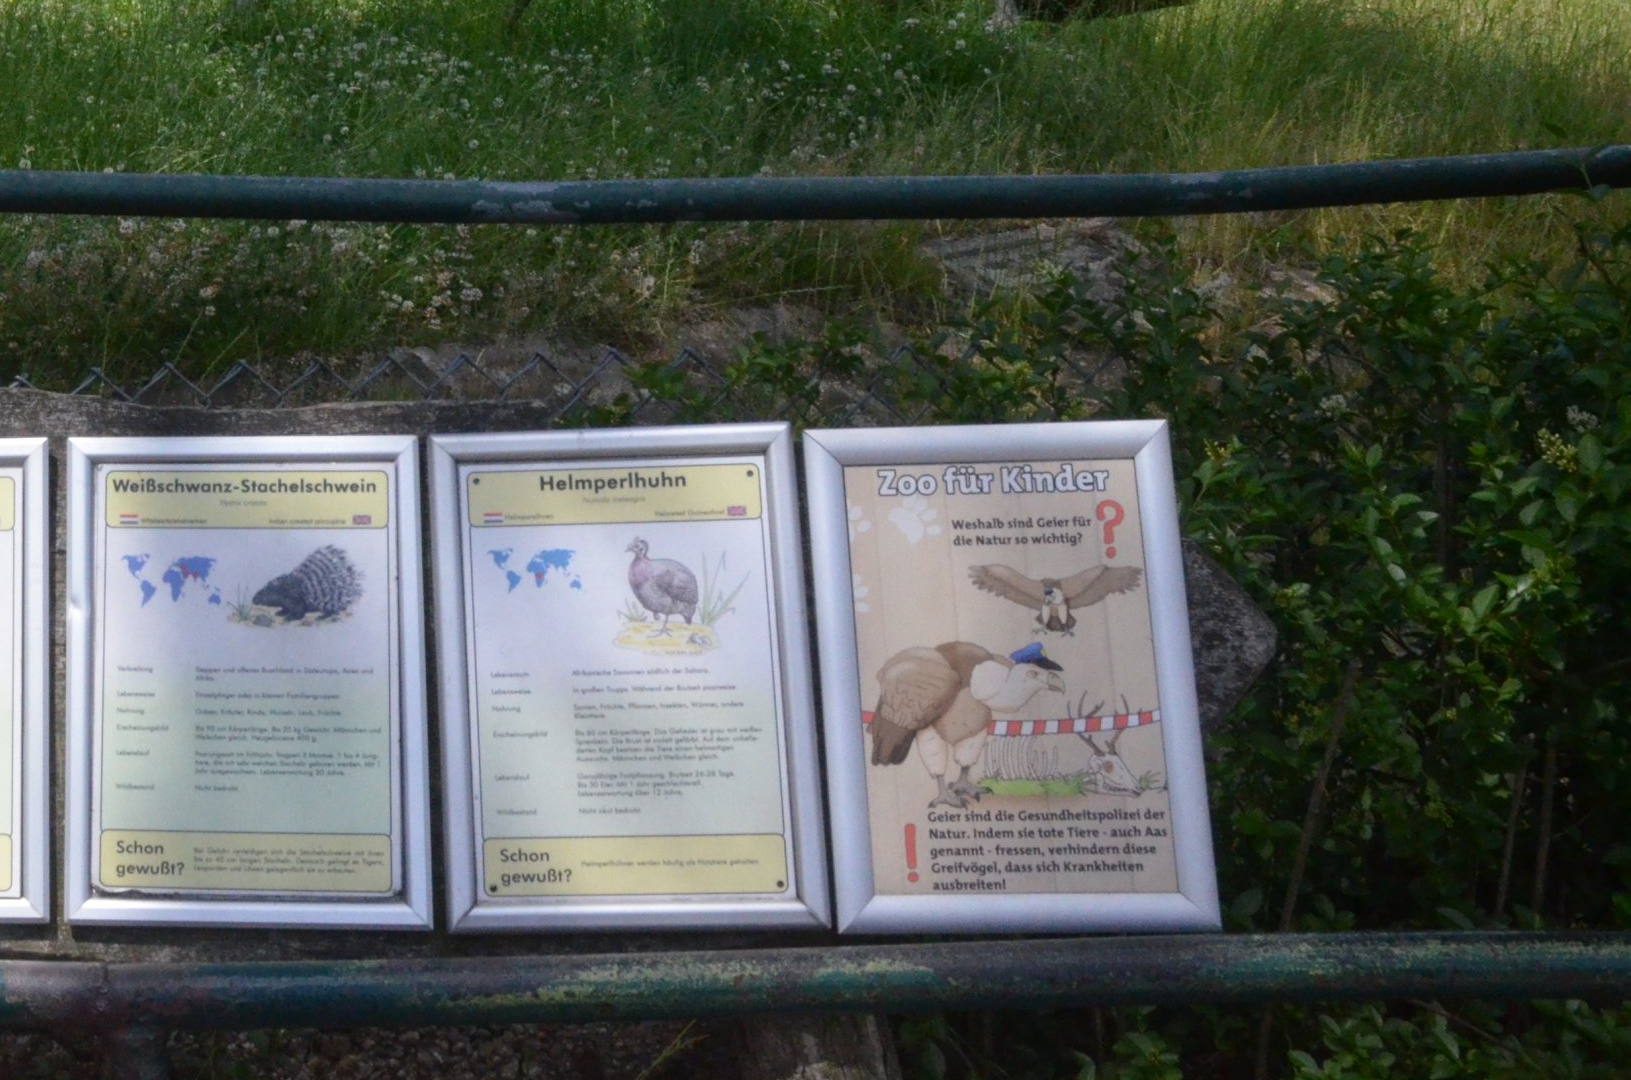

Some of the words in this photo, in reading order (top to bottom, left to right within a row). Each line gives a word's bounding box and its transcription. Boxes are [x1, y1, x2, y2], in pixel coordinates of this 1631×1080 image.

[113, 479, 377, 494] Weißschwanz-Stachelschwein
[539, 473, 686, 494] Helmperlhuhn
[877, 469, 937, 497] Zoo
[943, 465, 994, 495] für
[1001, 463, 1109, 494] Kinder
[952, 519, 1004, 530] Weshalb
[1007, 518, 1034, 529] sind
[1037, 517, 1069, 528] Geier
[1072, 516, 1092, 528] für
[953, 535, 973, 546] die
[976, 534, 1011, 545] Natur
[1015, 536, 1029, 545] so
[1031, 533, 1083, 547] wichtig?
[928, 811, 961, 822] Geier
[964, 810, 991, 822] sind
[995, 810, 1014, 822] die
[1018, 809, 1140, 824] Gesundheitspolizei
[1144, 809, 1164, 821] der
[929, 828, 970, 840] Natur.
[973, 828, 1014, 839] Indem
[1018, 827, 1035, 839] sie
[1038, 827, 1064, 839] tote
[1067, 827, 1099, 838] Tiere
[1111, 826, 1142, 838] auch
[1145, 826, 1167, 838] Aas
[116, 840, 164, 855] Schon
[930, 846, 984, 860] genannt
[995, 844, 1045, 857] fressen,
[1048, 843, 1120, 855] verhindern
[1123, 843, 1156, 855] diese
[500, 849, 550, 863] Schon
[116, 862, 185, 878] gewußt?
[931, 862, 1001, 877] Greifvögel,
[1004, 861, 1032, 873] dass
[1036, 861, 1060, 872] sich
[1063, 860, 1144, 872] Krankheiten
[501, 869, 572, 886] gewußt?
[932, 879, 1006, 891] ausbreiten!
